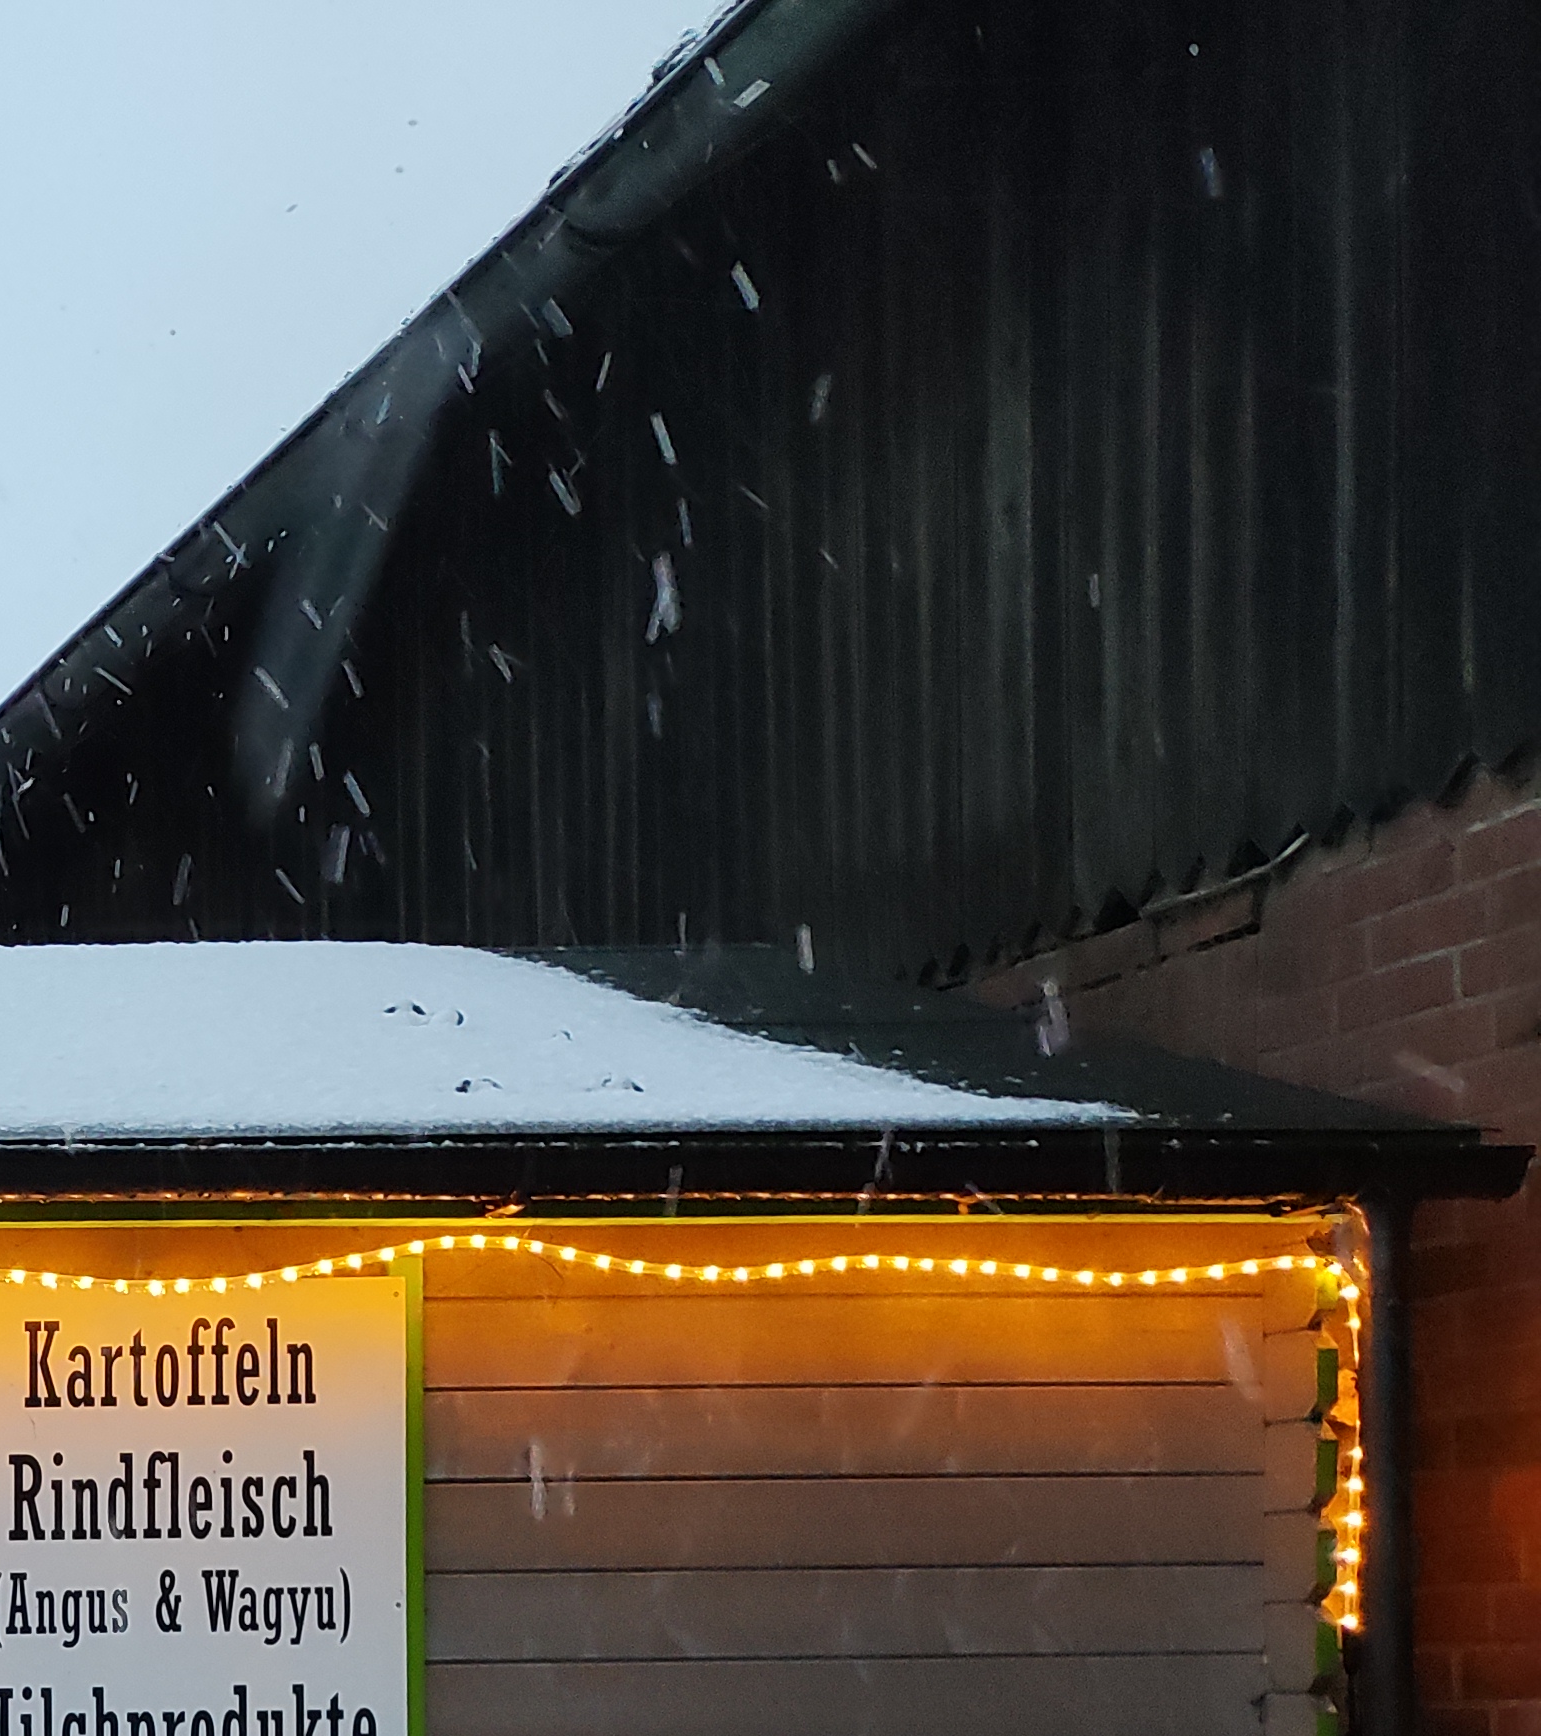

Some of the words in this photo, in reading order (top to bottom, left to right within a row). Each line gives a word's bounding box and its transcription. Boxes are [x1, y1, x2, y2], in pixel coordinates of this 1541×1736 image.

[23, 1317, 317, 1409] Kartoffeln
[8, 1449, 334, 1542] Rindfleisch
[155, 1568, 183, 1634] &
[201, 1567, 352, 1647] Wagyu)
